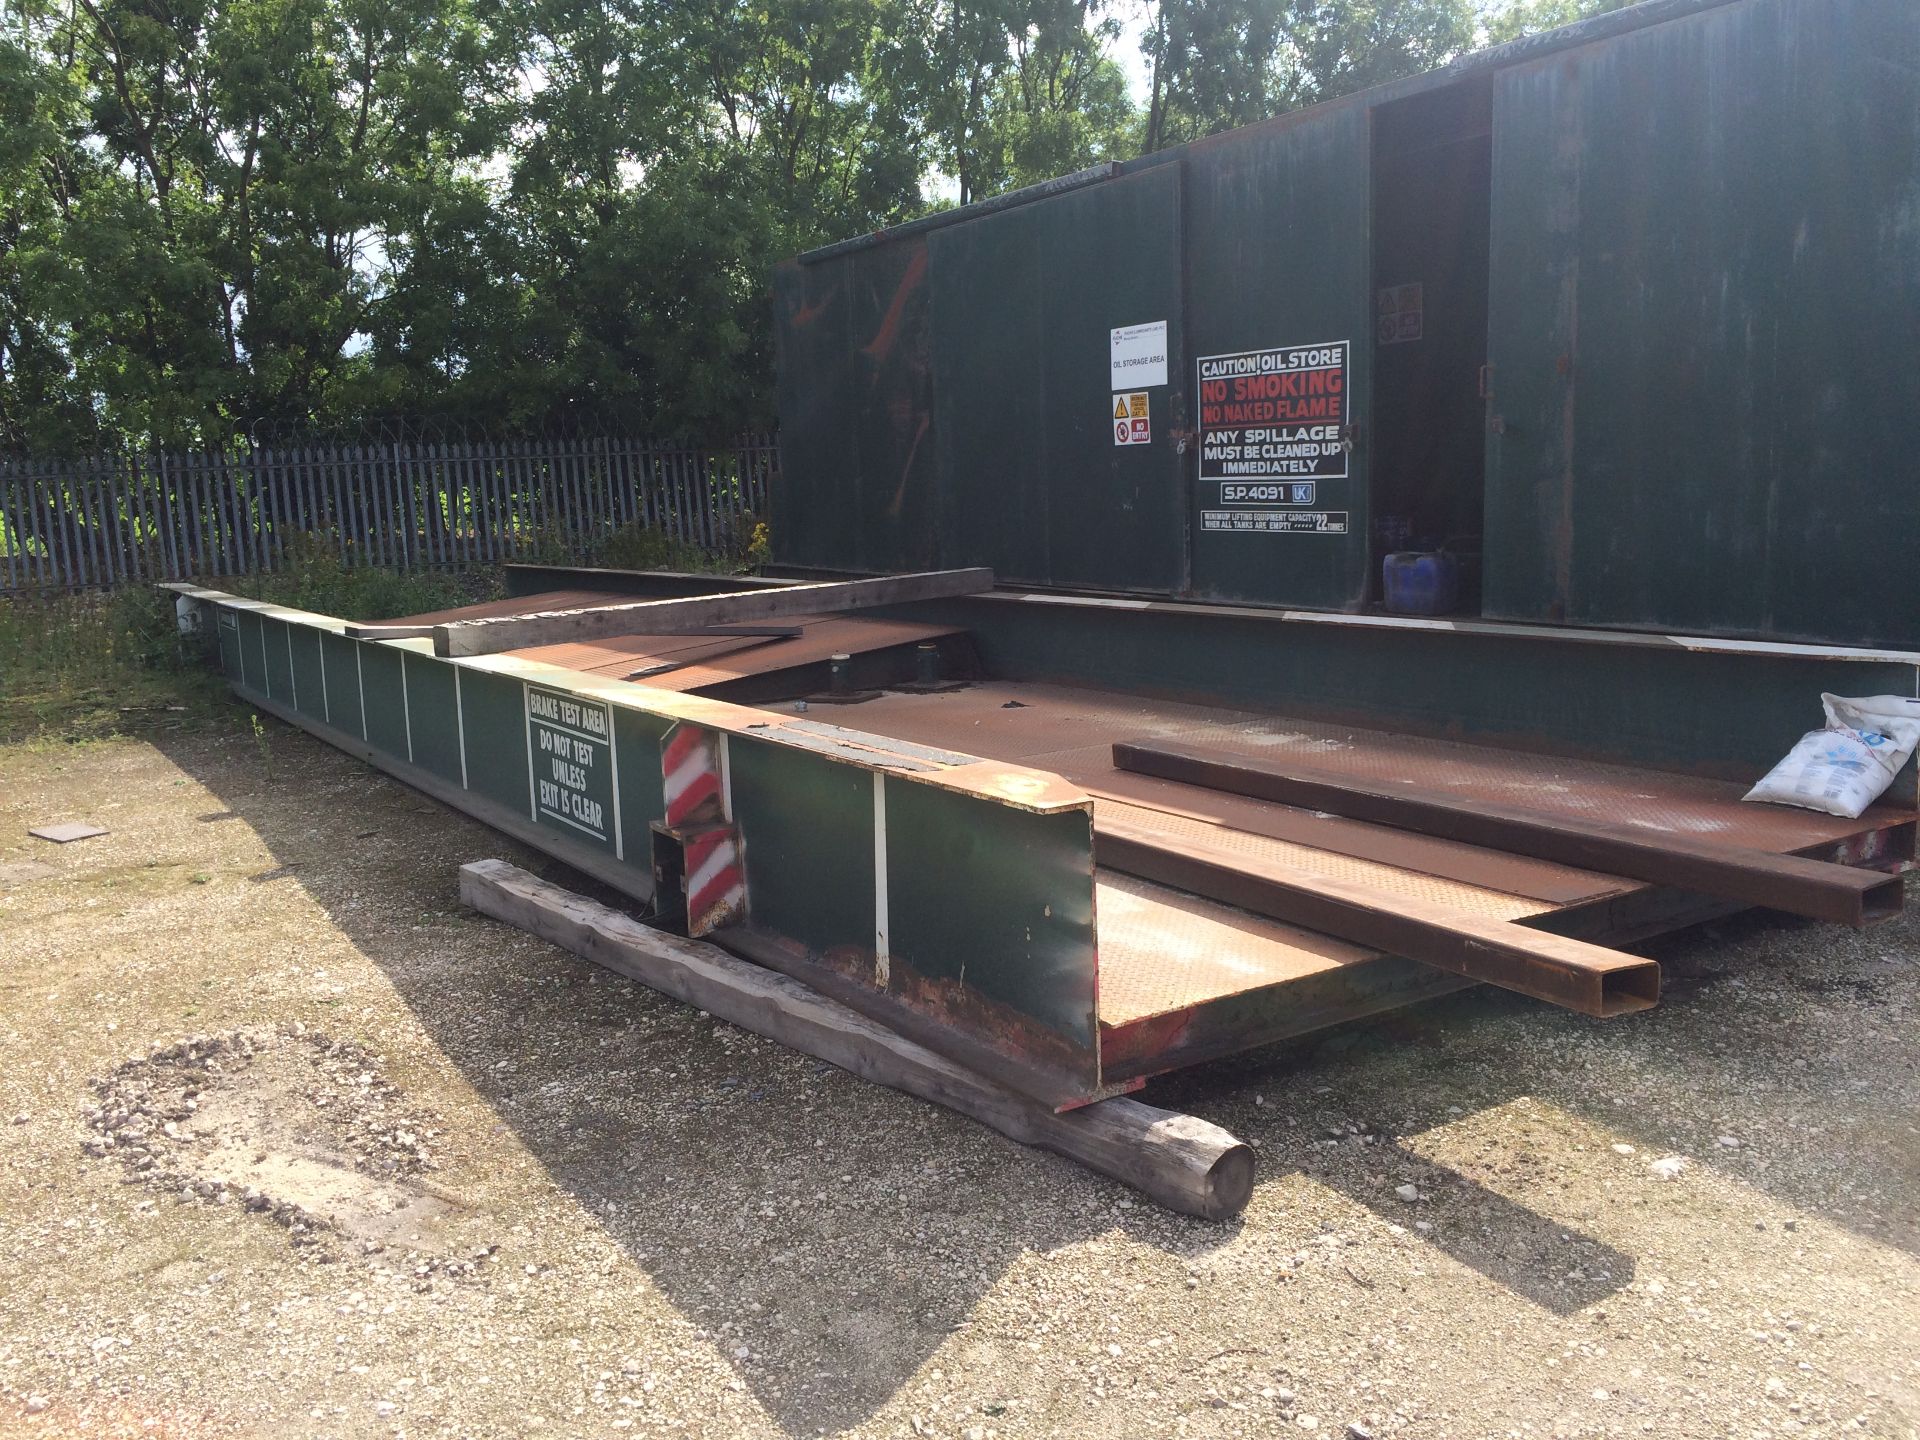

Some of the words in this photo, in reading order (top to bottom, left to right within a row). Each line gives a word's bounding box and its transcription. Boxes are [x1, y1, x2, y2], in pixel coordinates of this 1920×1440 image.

[1113, 361, 1122, 369] OIL
[1123, 357, 1149, 367] STORAGE
[1149, 355, 1165, 364] AREA
[1202, 354, 1261, 377] CAUTION!
[1261, 353, 1287, 370] OIL
[1288, 348, 1342, 367] STORE
[1202, 380, 1227, 403] NO
[1235, 369, 1342, 401] SMOKING
[1203, 405, 1221, 424] NO
[1224, 401, 1273, 423] NAKED
[1277, 396, 1341, 418] FLAME
[1136, 422, 1145, 431] NO
[1205, 430, 1239, 444] ANY
[1244, 426, 1340, 443] SPILLAGE
[1204, 446, 1241, 460] MUST
[1244, 446, 1260, 459] BE
[1262, 443, 1320, 457] CLEANED
[1322, 442, 1342, 456] UP
[1222, 460, 1319, 474] IMMEDIATELY
[1224, 486, 1284, 500] S.P.4091
[1232, 513, 1253, 521] LIFTING
[1288, 514, 1316, 522] CAPACITY
[1316, 514, 1328, 531] 22
[1234, 521, 1253, 529] TANKS
[1269, 522, 1292, 530] EMPTY
[530, 692, 558, 721] BRAKE
[560, 700, 580, 727] TEST
[582, 707, 606, 736] AREA
[540, 728, 552, 751] DO
[553, 733, 571, 759] NOT
[573, 740, 593, 768] TEST
[552, 757, 587, 792] UNLESS
[540, 779, 559, 810] EXIT
[560, 788, 570, 814] IS
[572, 793, 604, 830] CLEAR
